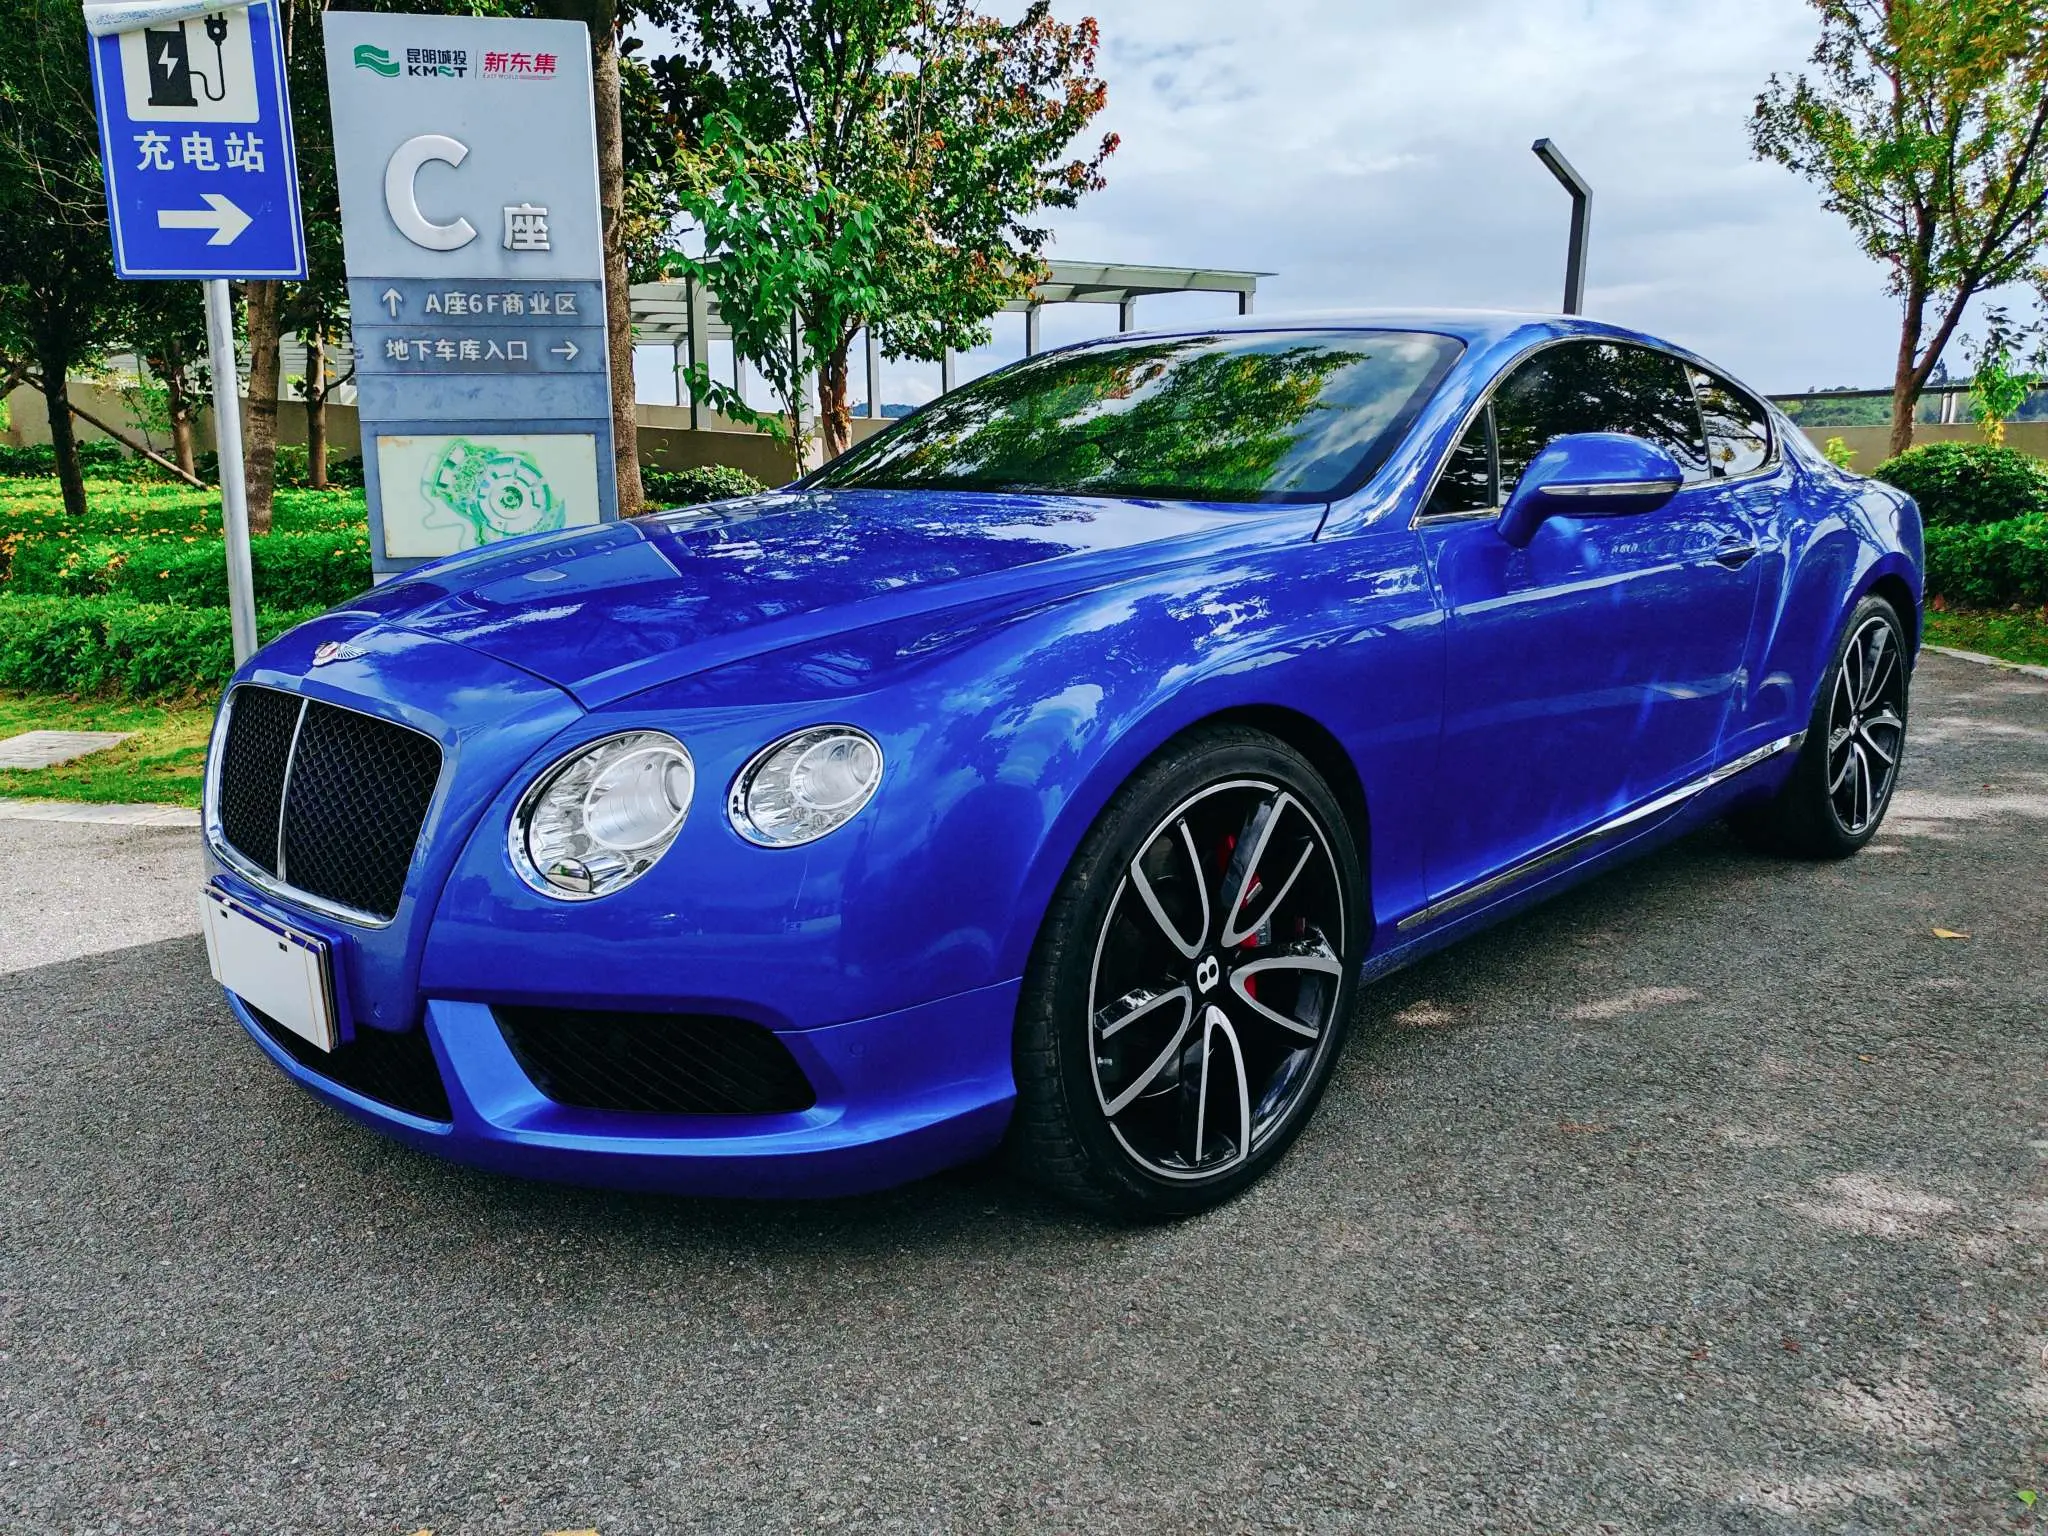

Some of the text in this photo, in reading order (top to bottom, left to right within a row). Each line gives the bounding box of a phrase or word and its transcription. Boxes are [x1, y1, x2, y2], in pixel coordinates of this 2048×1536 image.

[407, 48, 467, 65] 昆明城投
[484, 52, 558, 74] 新东集
[133, 130, 265, 172] 充电站
[385, 134, 550, 251] C 座
[425, 291, 578, 315] A座6F商业区
[386, 339, 527, 361] 地下车库入口
[1197, 955, 1219, 994] B
